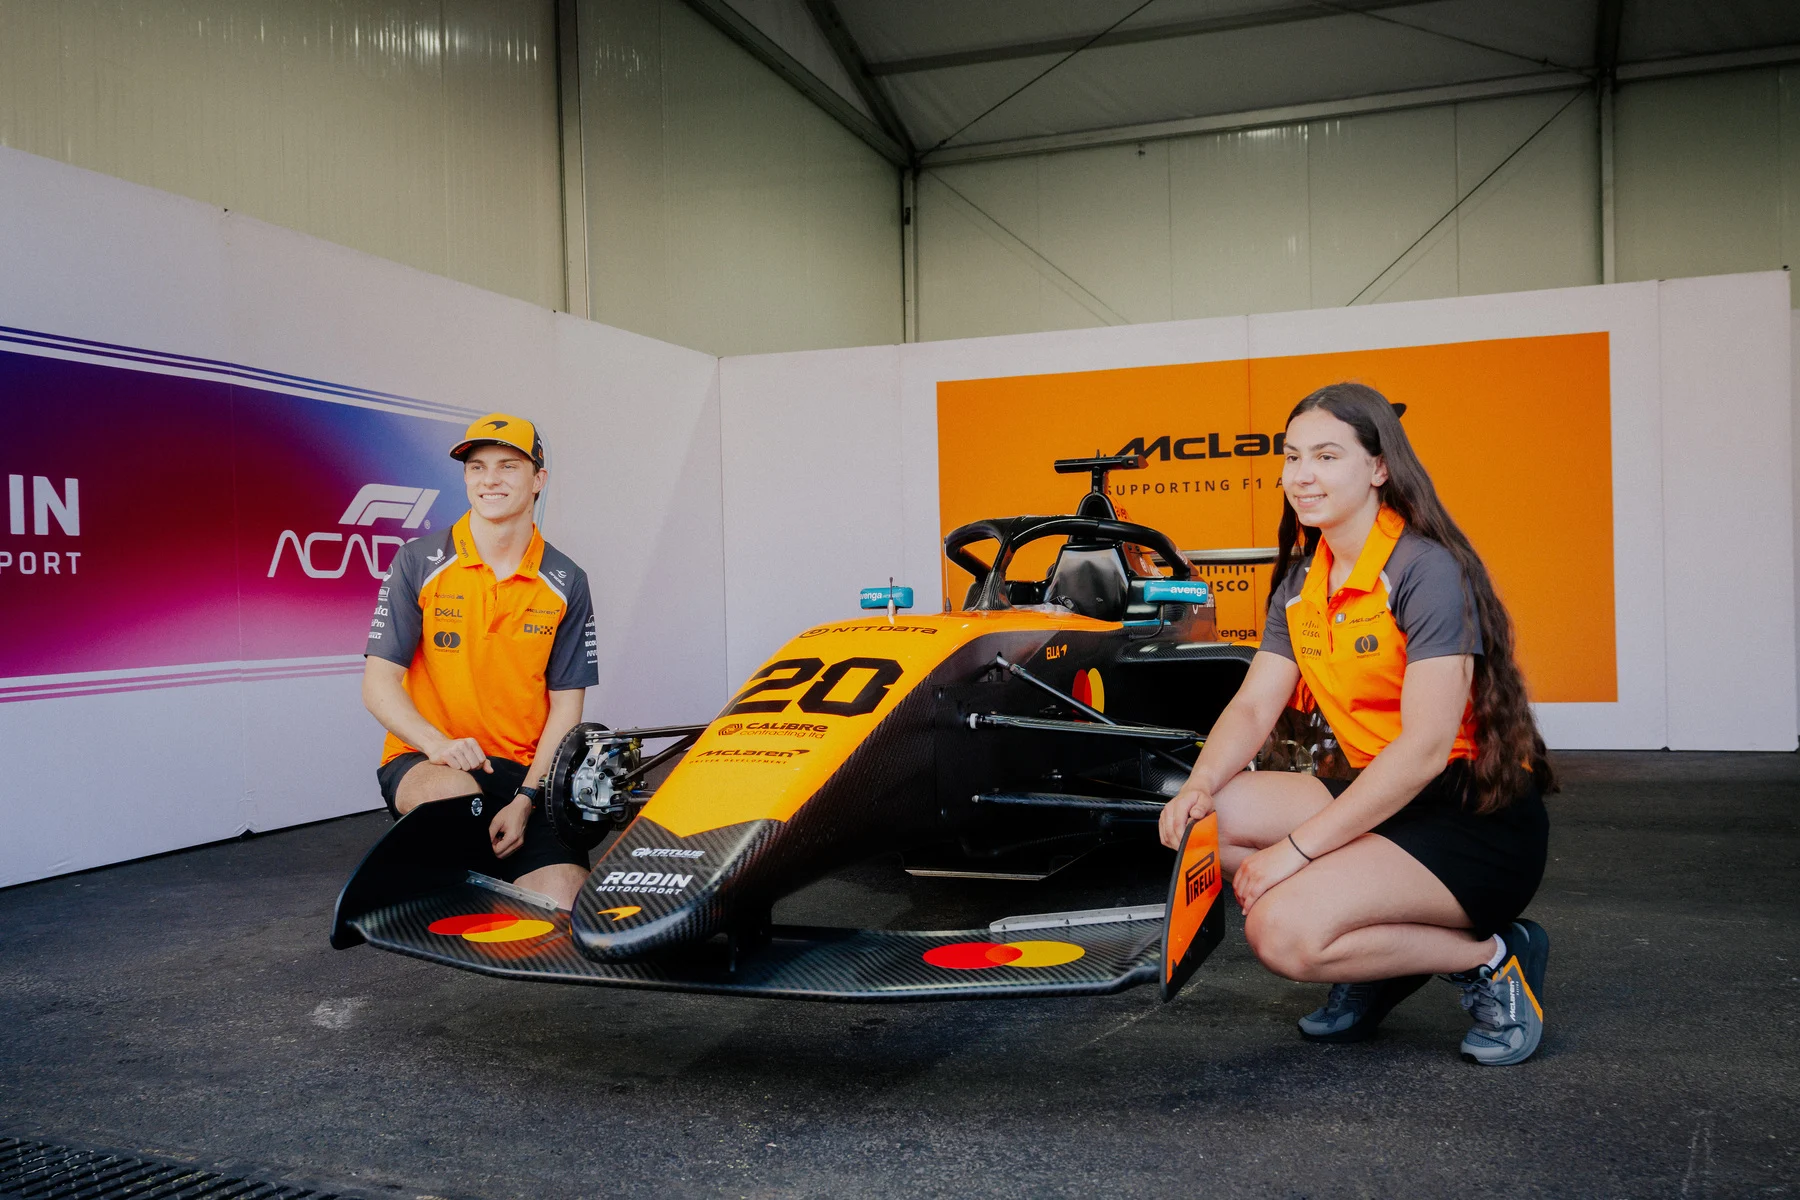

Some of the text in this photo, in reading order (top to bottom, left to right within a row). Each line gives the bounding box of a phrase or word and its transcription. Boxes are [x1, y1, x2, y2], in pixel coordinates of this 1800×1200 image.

[1113, 432, 1288, 462] McLar
[1243, 478, 1262, 489] F1
[338, 483, 441, 529] F1
[1170, 586, 1207, 597] avenga
[1210, 580, 1249, 592] ISCO
[434, 607, 463, 618] DELL
[524, 624, 553, 635] OKX
[1219, 629, 1257, 640] enga
[1046, 646, 1060, 660] ELLA
[1301, 647, 1322, 656] ODIN
[714, 657, 904, 720] 20
[740, 730, 826, 739] contracting ltd
[697, 749, 794, 758] McLaren
[650, 848, 706, 858] TATUUS
[602, 871, 694, 888] RODIN
[1185, 850, 1216, 907] PIRELLI
[596, 885, 683, 895] MOTORSPORT
